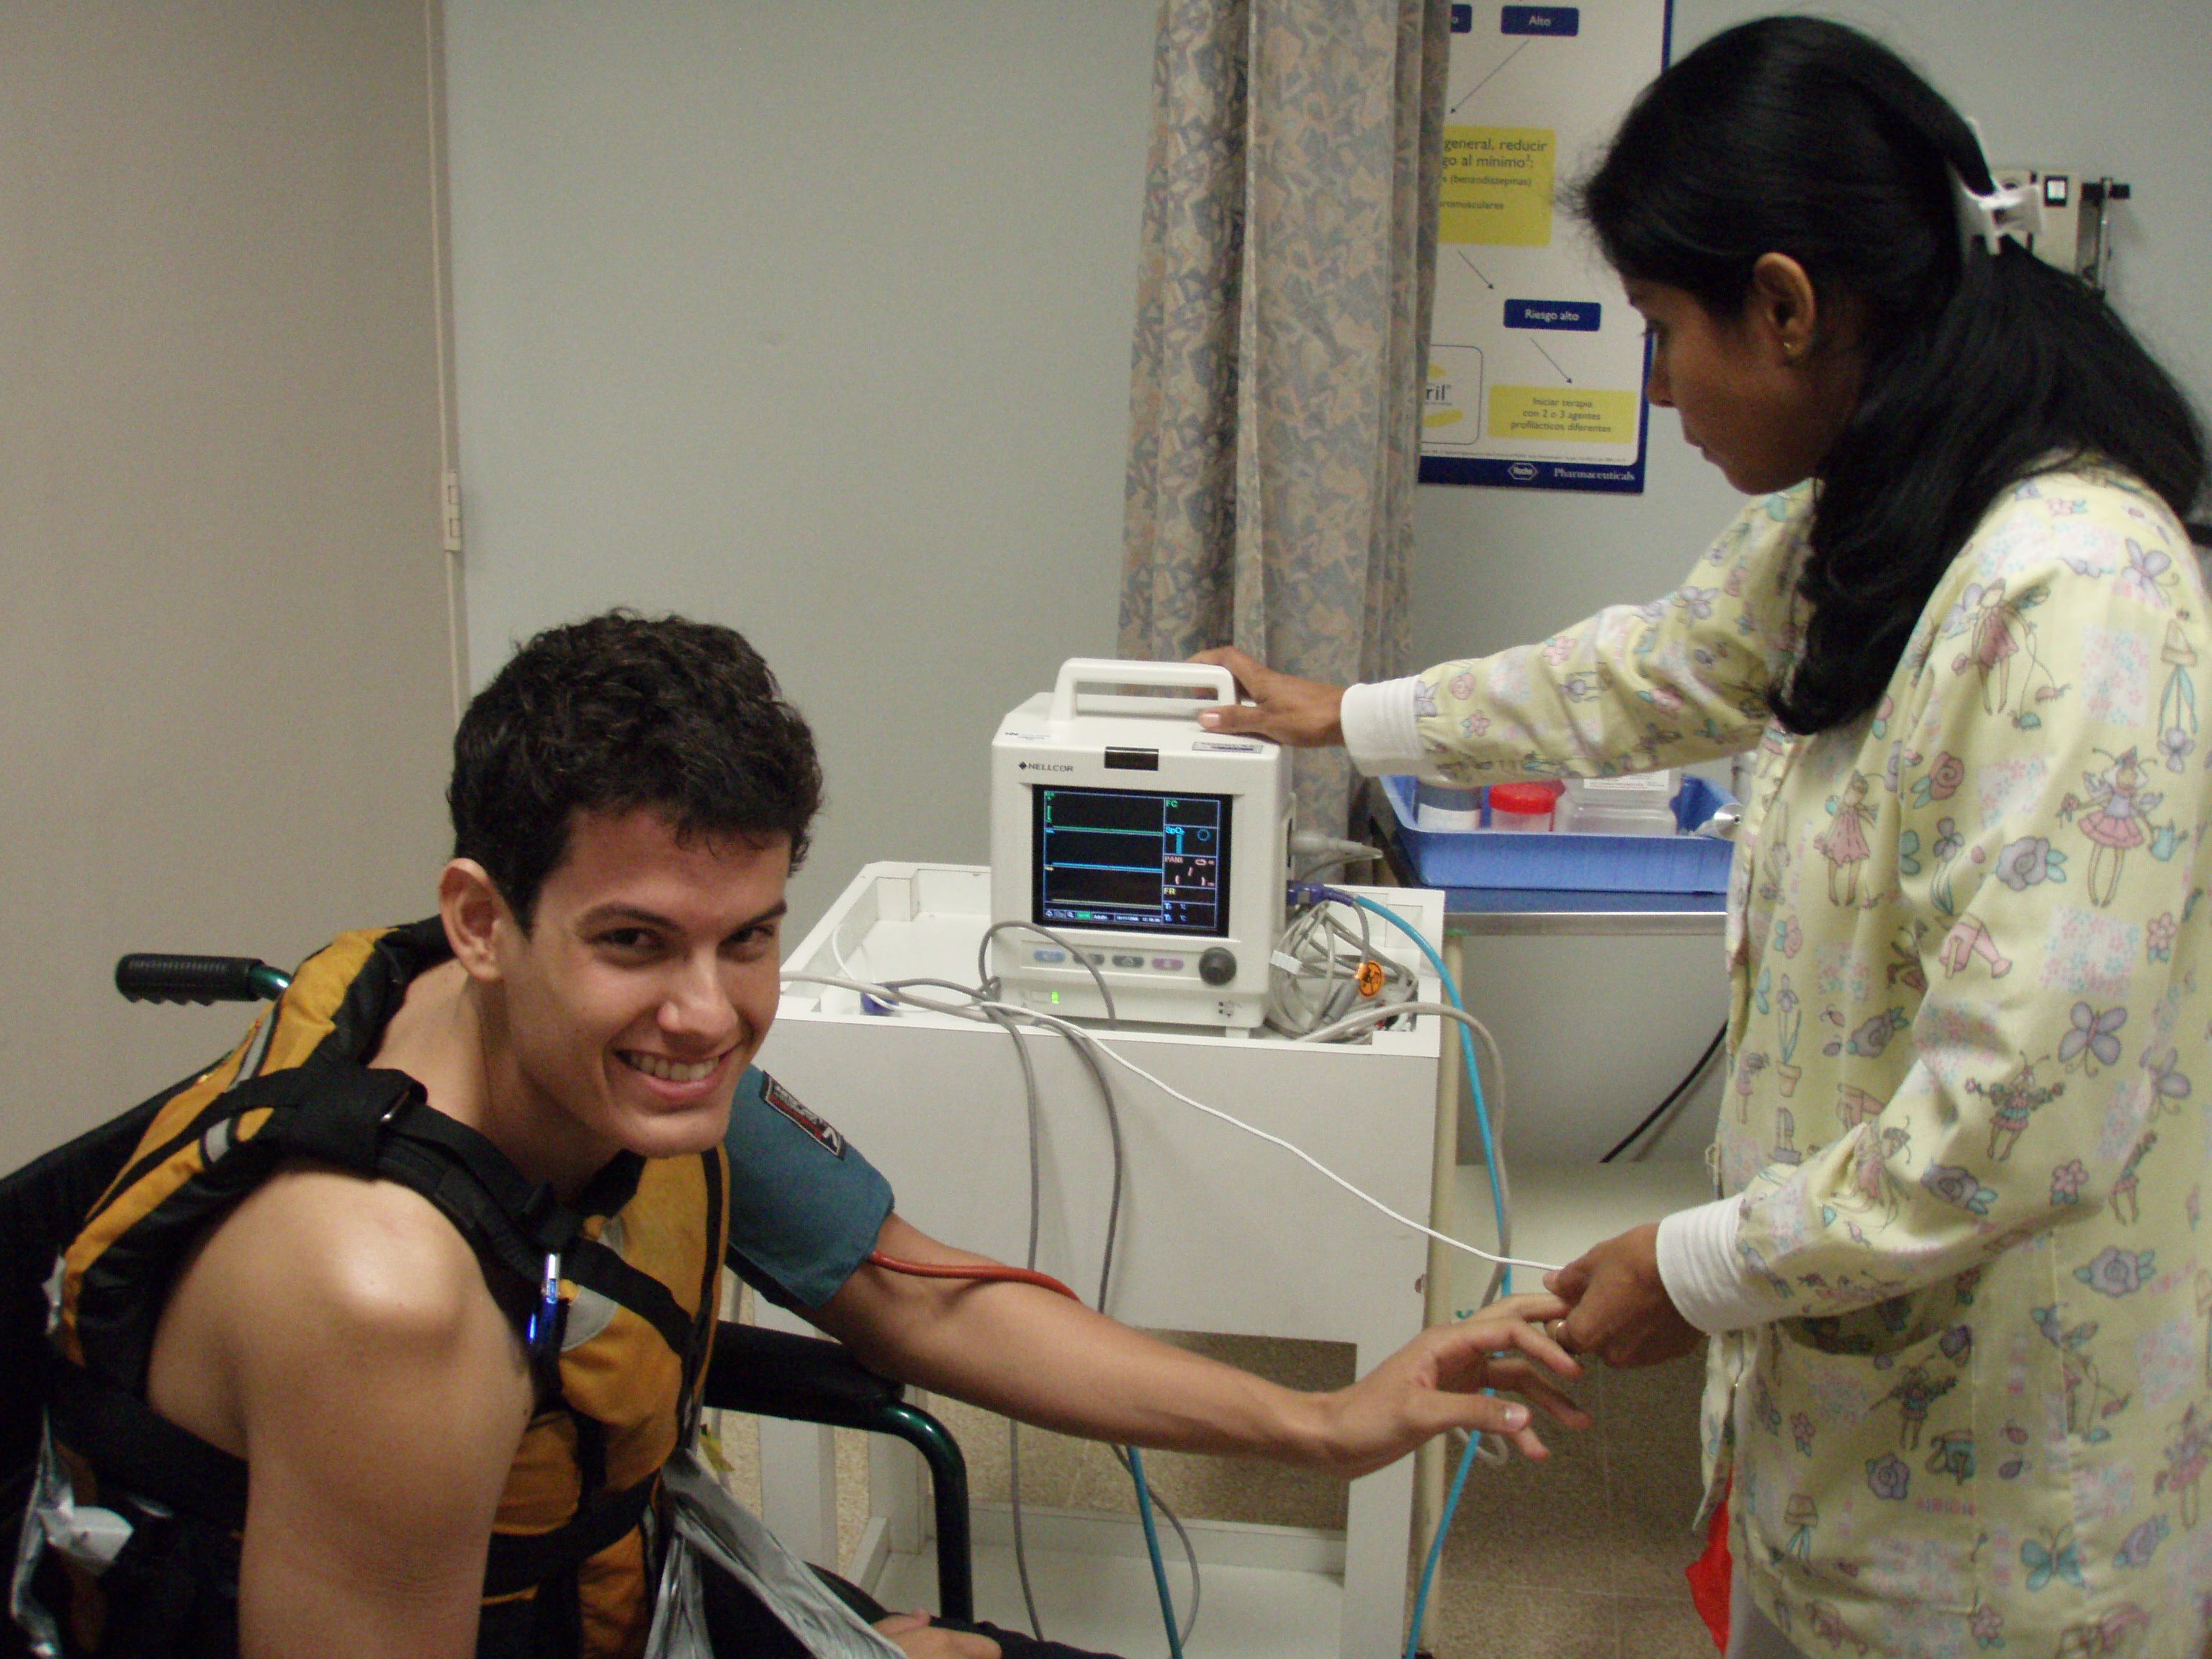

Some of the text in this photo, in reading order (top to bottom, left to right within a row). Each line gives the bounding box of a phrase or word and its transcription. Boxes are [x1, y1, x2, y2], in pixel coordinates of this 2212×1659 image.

[1500, 139, 1547, 151] reducir
[1462, 153, 1473, 166] al
[1525, 309, 1580, 323] Riesgo alto
[1554, 467, 1635, 481] Pharmaceuticals
[1028, 763, 1074, 772] NELLCOR
